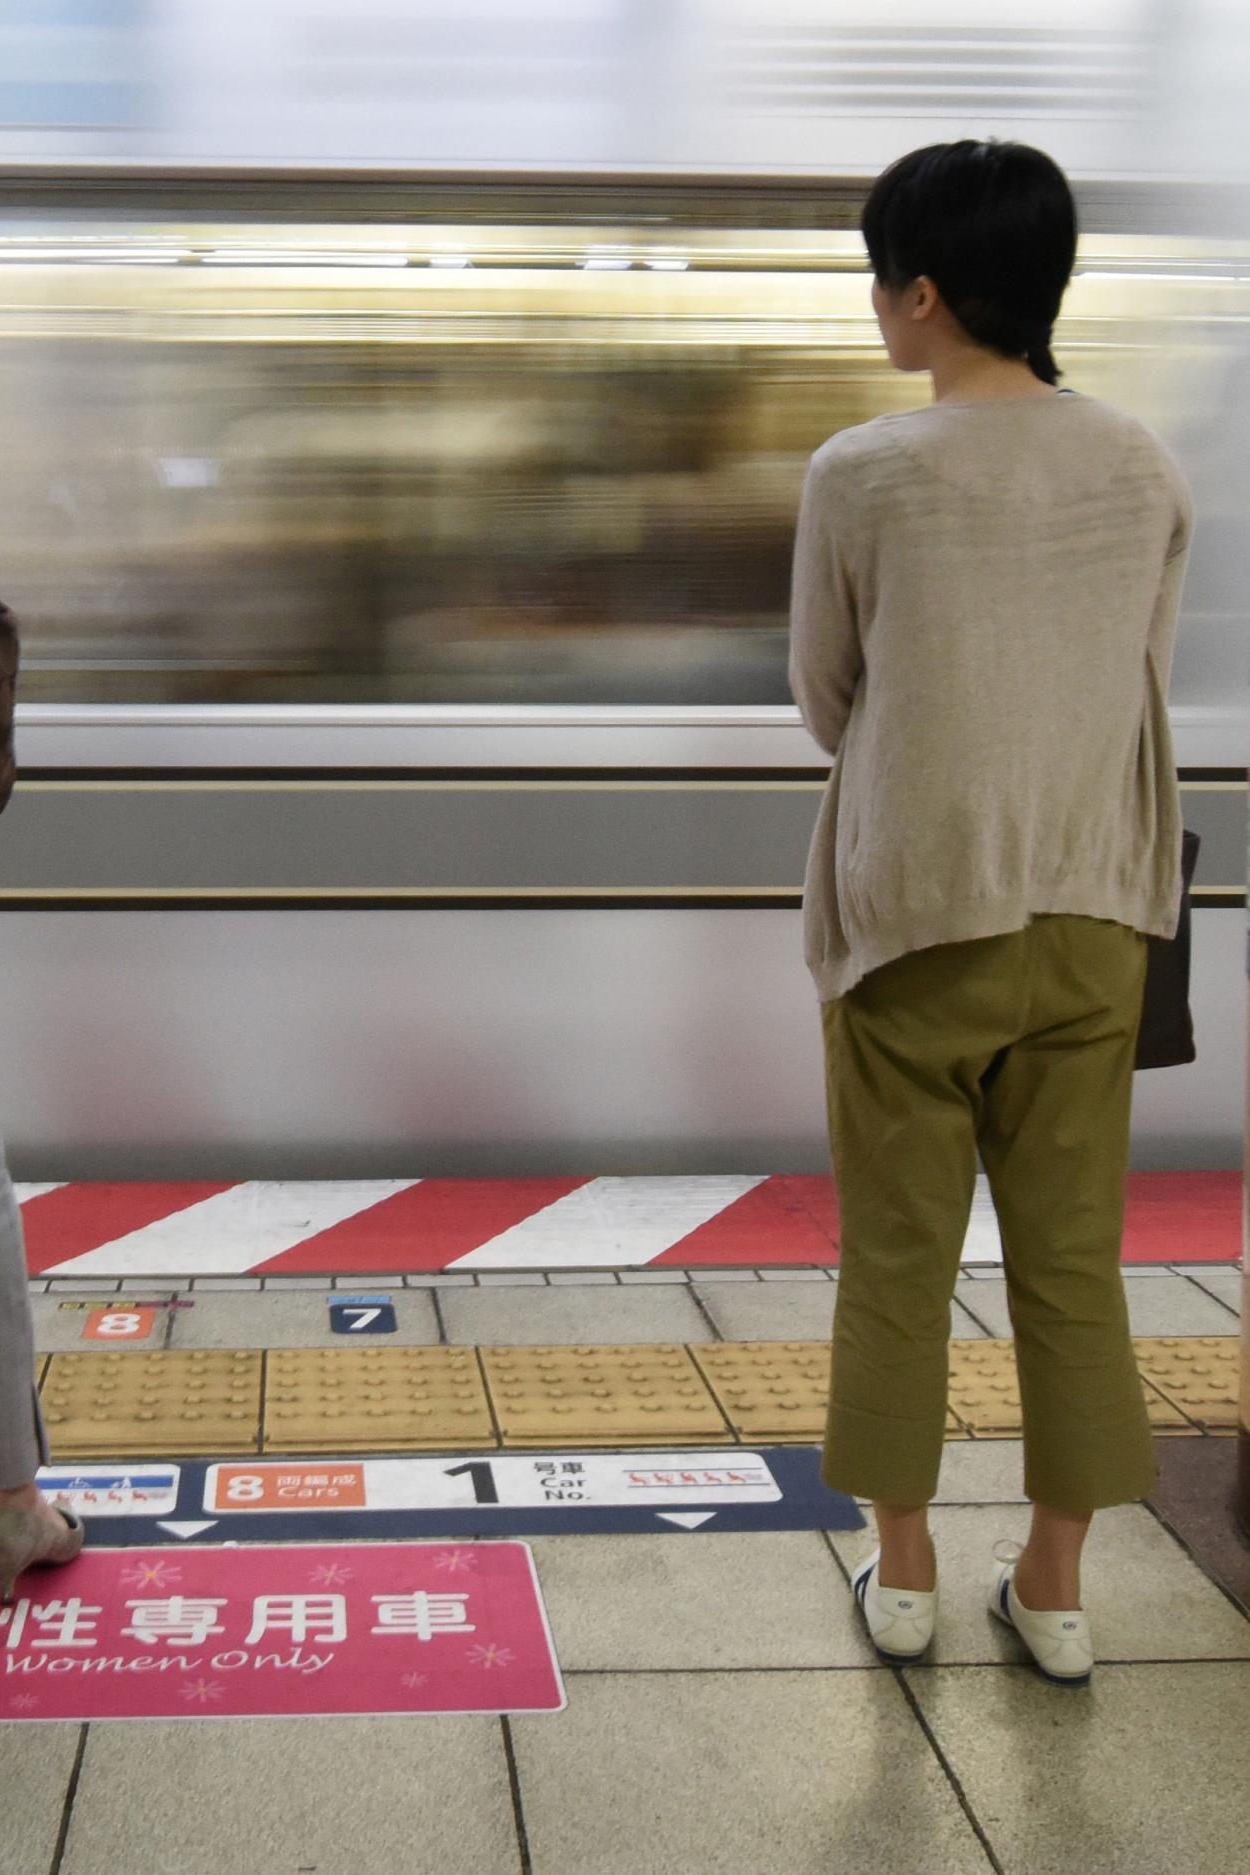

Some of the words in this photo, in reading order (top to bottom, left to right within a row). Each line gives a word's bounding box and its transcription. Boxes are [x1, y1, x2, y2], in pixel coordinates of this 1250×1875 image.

[96, 1313, 142, 1334] 8
[342, 1308, 383, 1331] 7
[533, 1461, 586, 1476] 号車
[227, 1475, 264, 1501] 8
[276, 1474, 357, 1487] 両編成
[443, 1460, 500, 1504] 1
[540, 1477, 587, 1488] Car
[277, 1487, 340, 1498] Cars
[545, 1490, 592, 1501] No.
[5, 1650, 206, 1676] Women
[209, 1646, 336, 1676] Only
